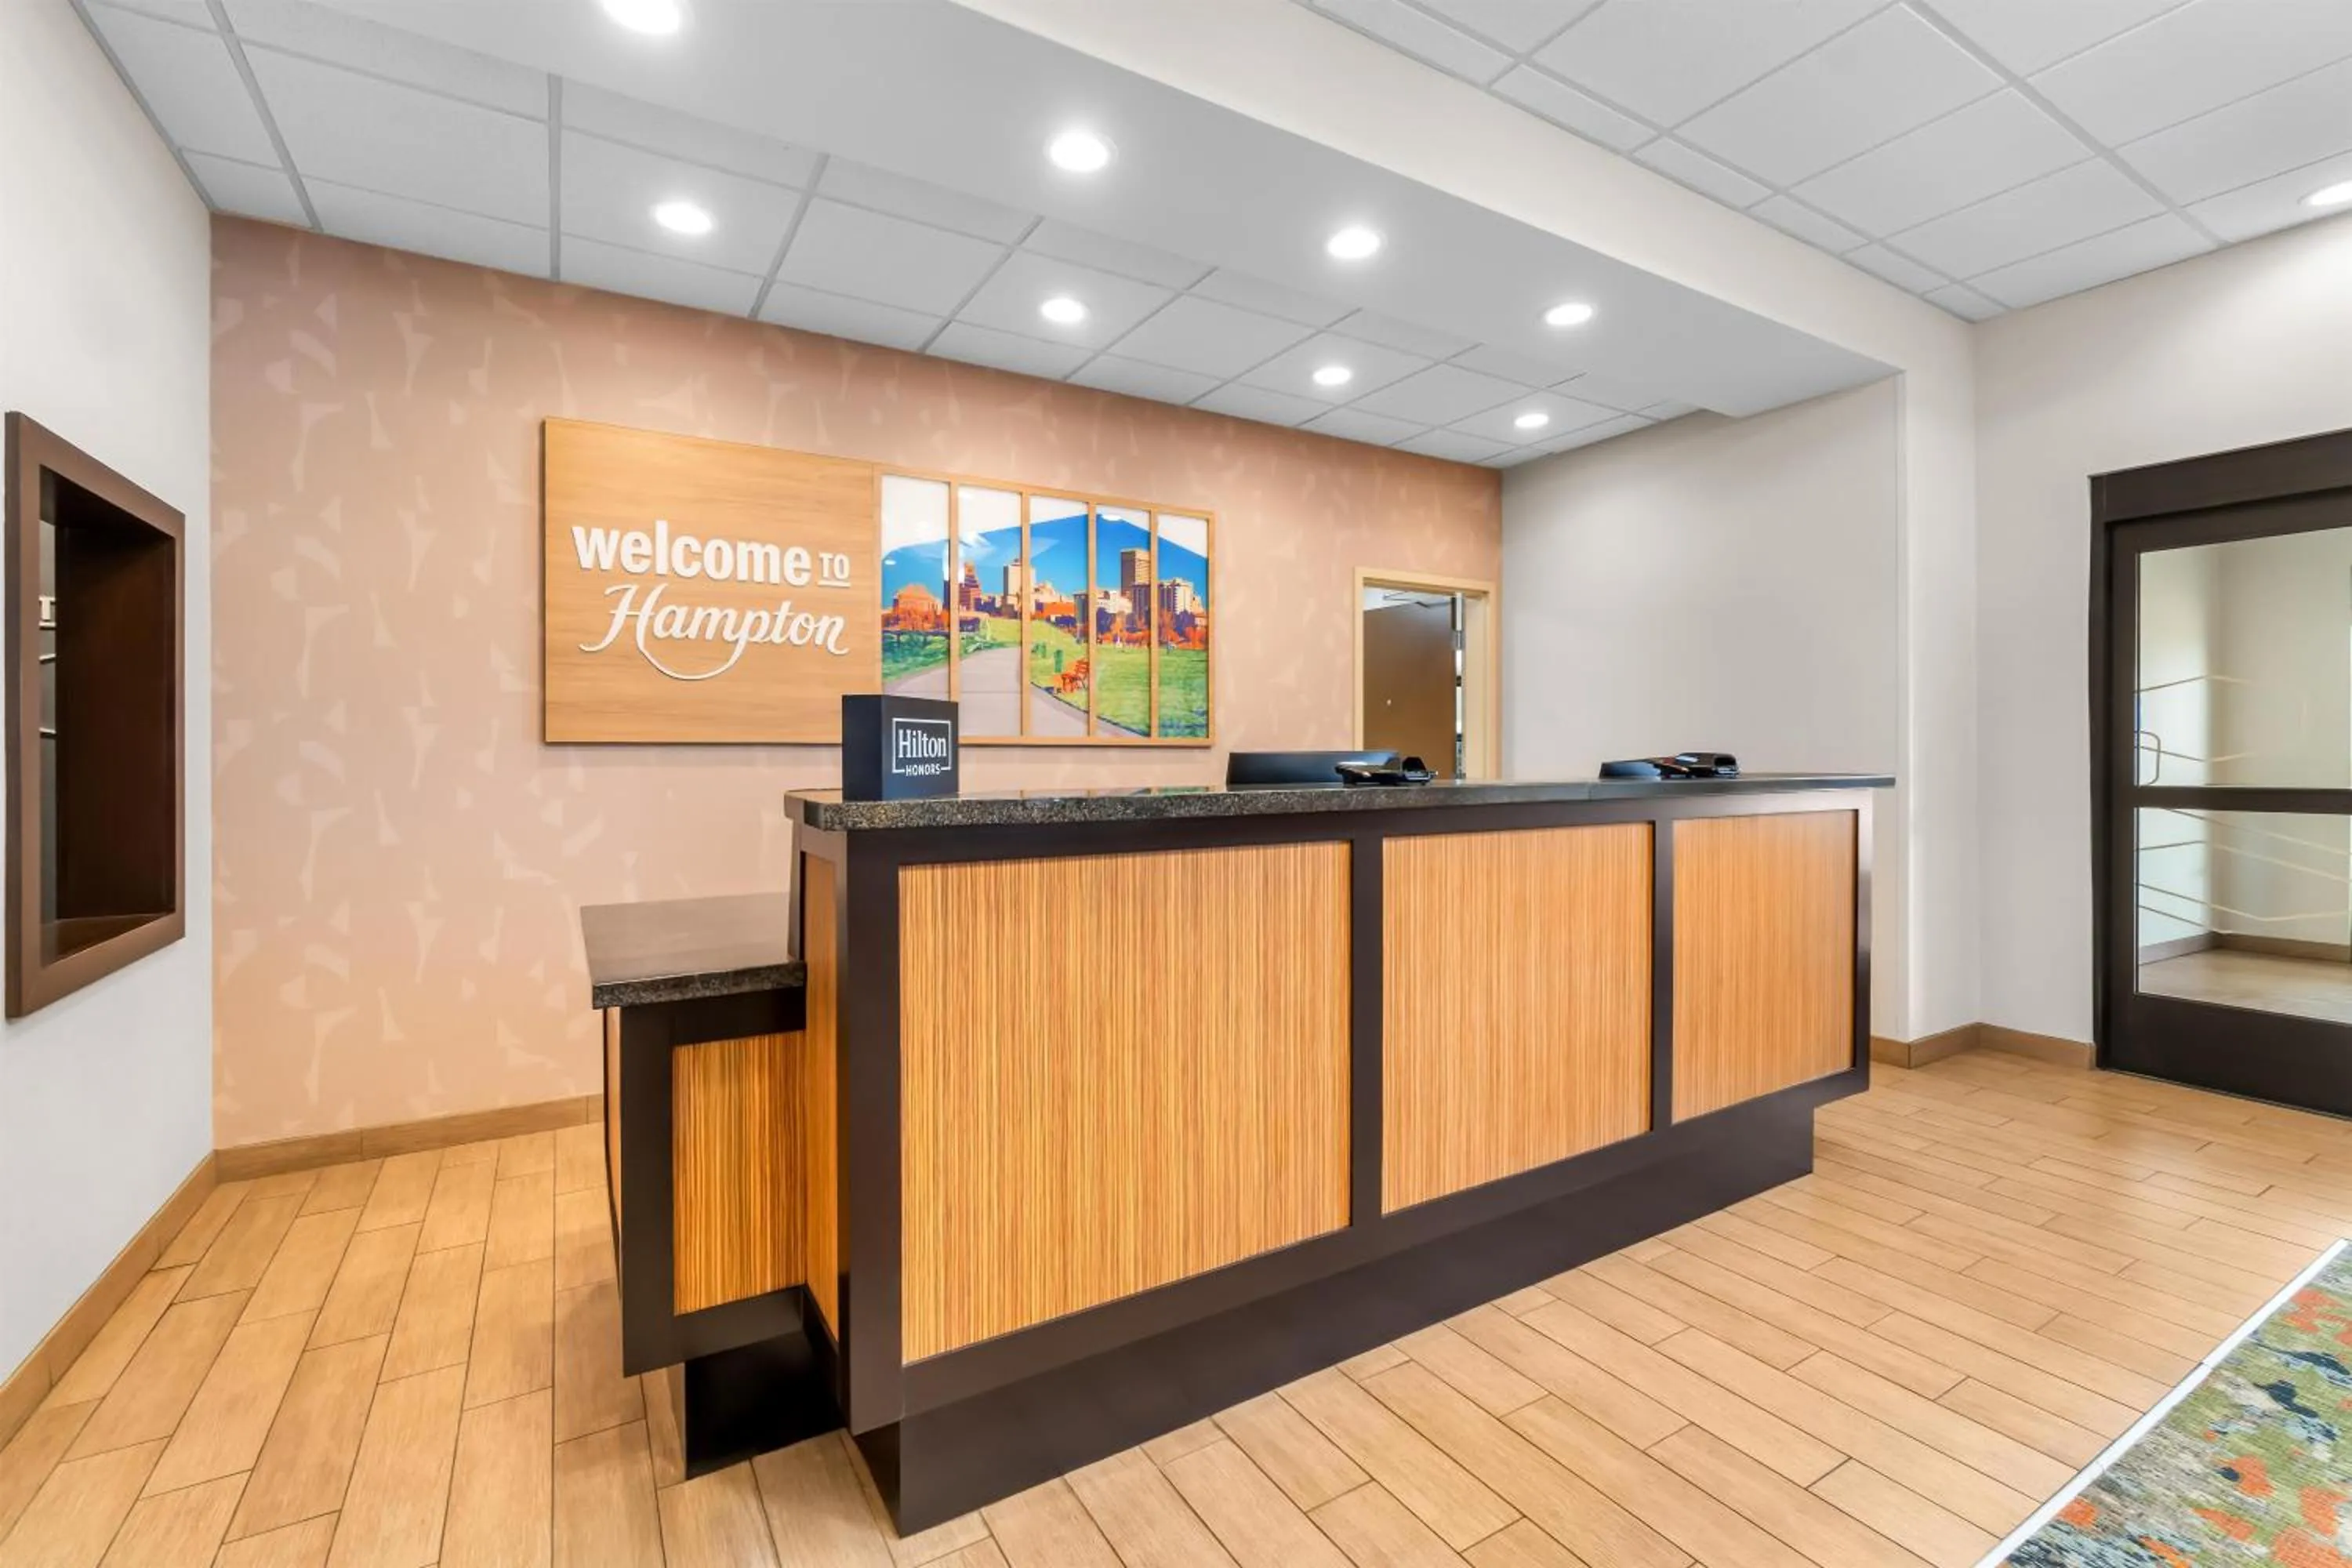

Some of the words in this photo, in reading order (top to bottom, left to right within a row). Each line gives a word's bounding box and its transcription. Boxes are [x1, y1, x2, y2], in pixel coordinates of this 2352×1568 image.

[572, 521, 811, 586] welcome
[818, 552, 850, 582] TO
[579, 584, 849, 680] Hampton
[898, 729, 946, 758] Hilton
[906, 764, 941, 776] HONORS
